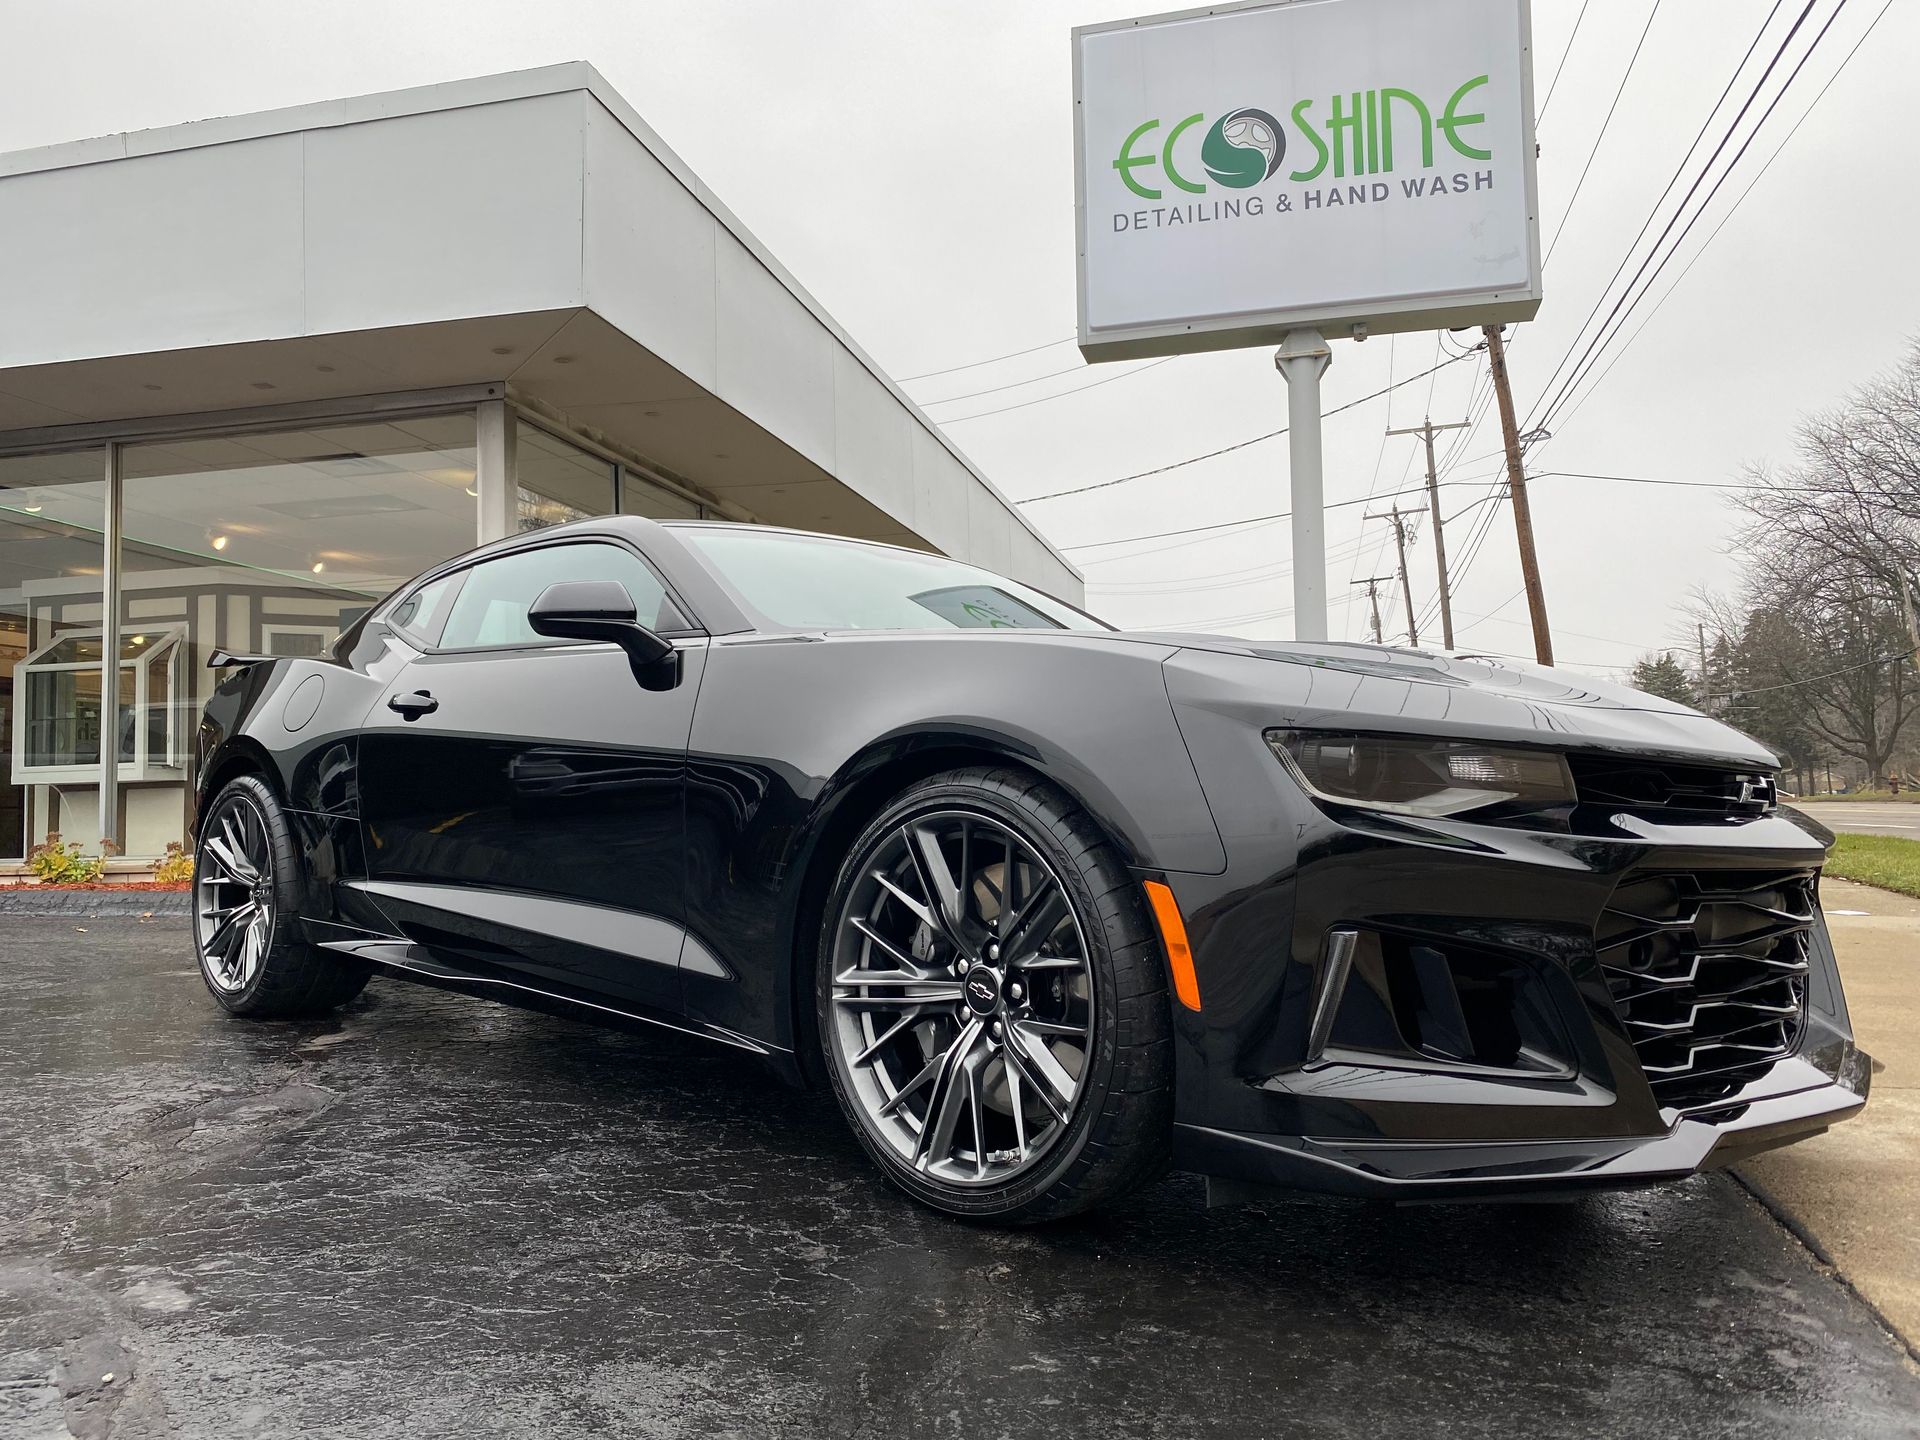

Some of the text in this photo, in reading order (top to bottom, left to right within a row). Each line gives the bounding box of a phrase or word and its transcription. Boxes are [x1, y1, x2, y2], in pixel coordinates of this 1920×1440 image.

[1112, 75, 1492, 200] ECOSHINE
[1113, 169, 1494, 233] DETAILING & HAND WASH
